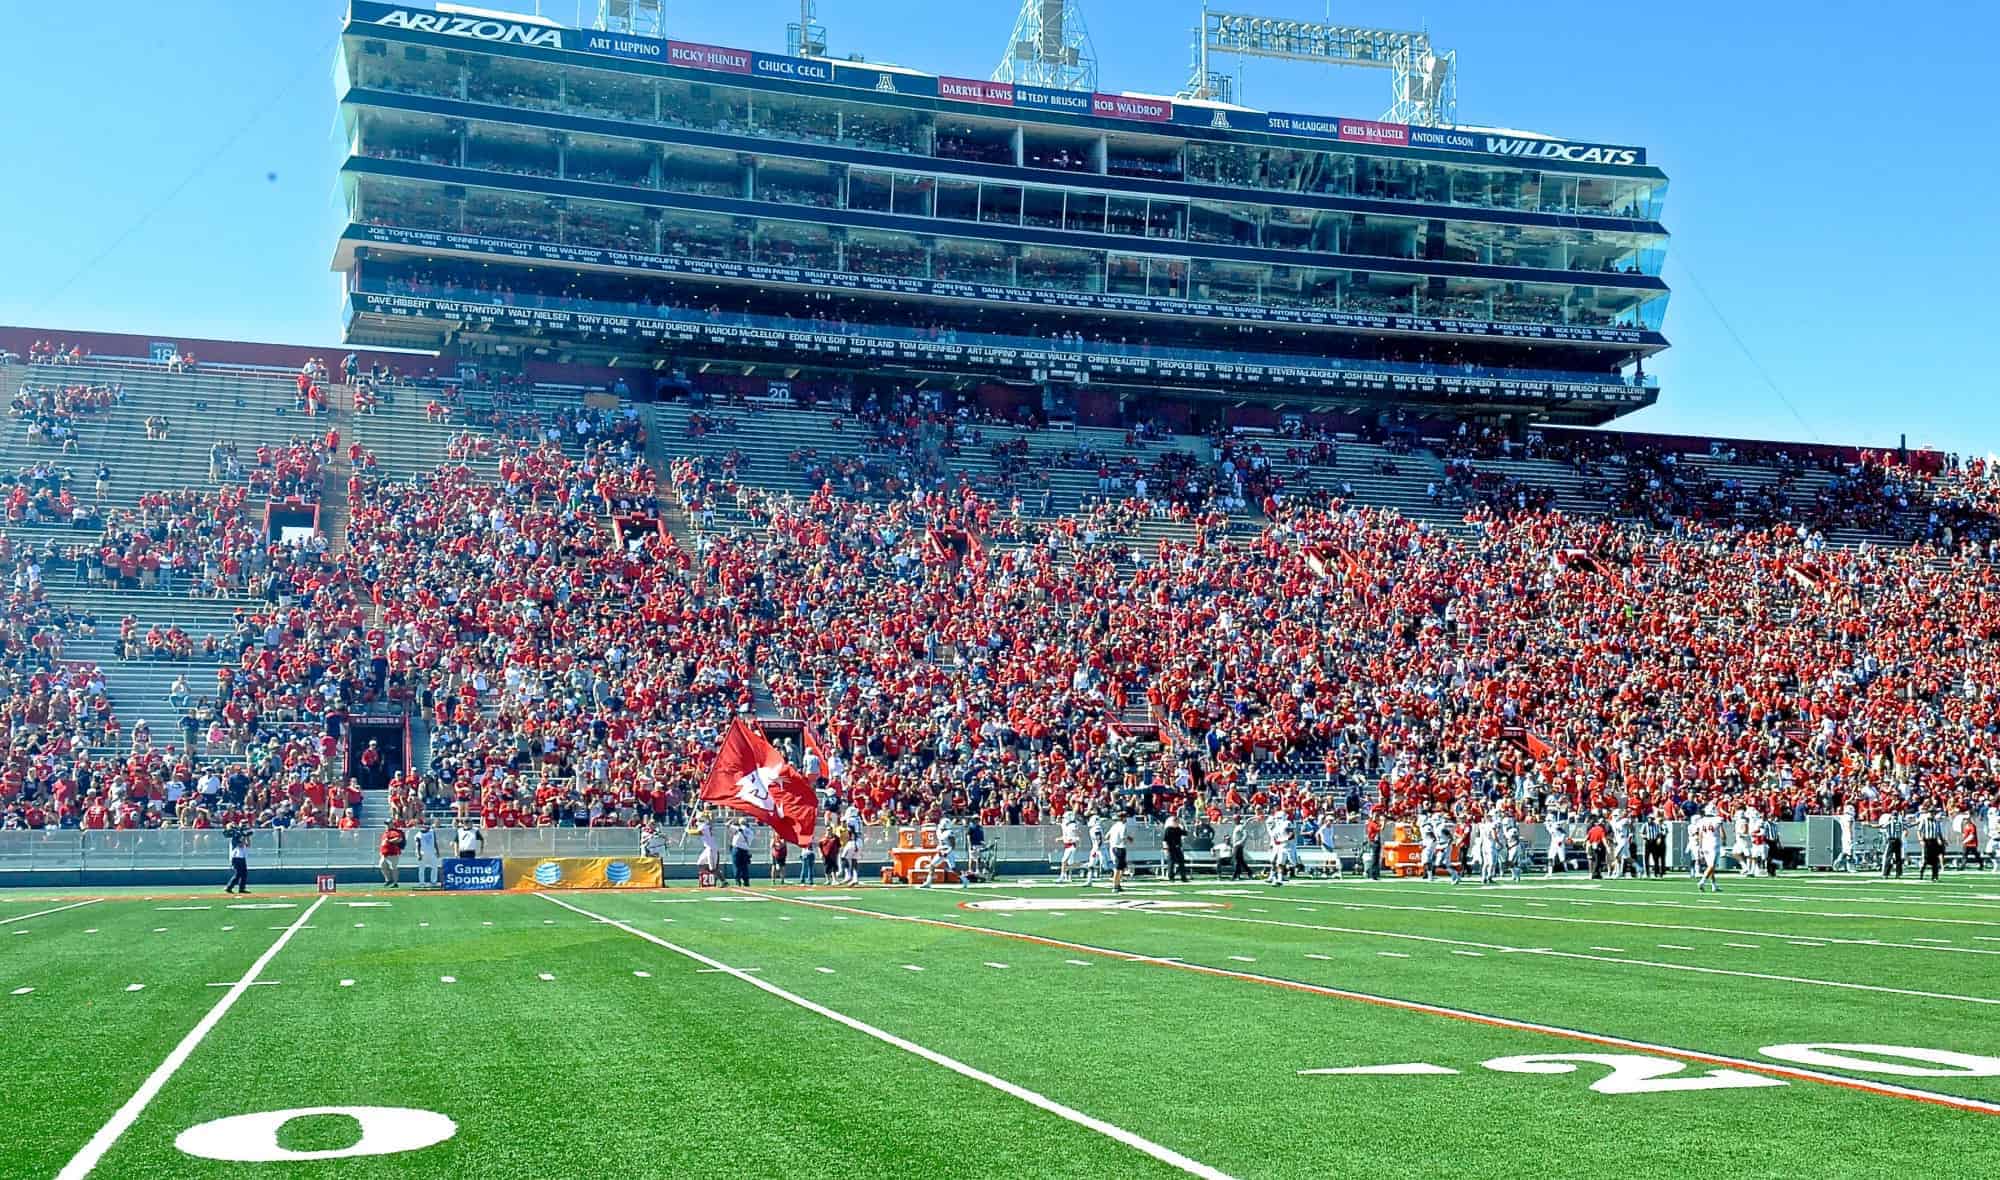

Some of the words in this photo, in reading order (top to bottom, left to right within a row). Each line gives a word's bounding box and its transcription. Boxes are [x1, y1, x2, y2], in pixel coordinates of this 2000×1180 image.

[375, 10, 562, 48] ARIZONA
[589, 37, 610, 50] ART
[614, 39, 660, 56] LUPPINO
[671, 48, 704, 63] RICKY
[706, 52, 748, 68] HUNLEY
[758, 59, 793, 75] CHUCK
[796, 63, 825, 79] CECIL
[942, 83, 982, 97] DARRYLL
[985, 88, 1012, 100] LEWIS
[1027, 93, 1048, 104] TEDY
[1050, 95, 1087, 108] BRUSCHI
[1093, 99, 1113, 111] ROB
[1116, 102, 1163, 116] WALDROP
[1268, 117, 1289, 129] STEVE
[1342, 125, 1364, 136] CHRIS
[1411, 131, 1444, 145] ANTOINE
[1446, 135, 1474, 147] CASON
[1485, 136, 1636, 165] WILDCATS
[367, 295, 391, 305] DAVE
[434, 301, 459, 312] WALT
[462, 304, 504, 316] STANTON
[507, 308, 532, 318] WALT
[533, 310, 570, 322] NIELSEN
[577, 314, 600, 324] TONY
[635, 319, 664, 330] ALLAN
[665, 322, 700, 333] DURDEN
[704, 325, 737, 336] HAROLD
[788, 332, 812, 342] EDDIE
[814, 334, 846, 345] WILSON
[850, 337, 865, 346] TED
[866, 338, 894, 349] BLAND
[898, 341, 916, 350] TOM
[917, 342, 962, 354] GREENFIELD
[967, 346, 982, 355] ART
[984, 347, 1016, 358] LUPPINO
[153, 349, 173, 361] 18
[1047, 352, 1082, 362] WALLACE
[1087, 355, 1109, 364] CHRIS
[1156, 360, 1192, 370] THEOPOLIS
[1193, 362, 1209, 371] BELL
[1215, 364, 1233, 373] FRED
[1267, 367, 1295, 376] STEVEN
[1342, 372, 1360, 380] JOSH
[1392, 375, 1416, 383] CHUCK
[1417, 376, 1435, 384] CECIL
[769, 387, 789, 400] 20
[454, 863, 492, 874] Game
[321, 876, 335, 890] 10
[447, 874, 500, 886] Sponsor
[702, 875, 715, 886] 20
[175, 1106, 457, 1162] 0
